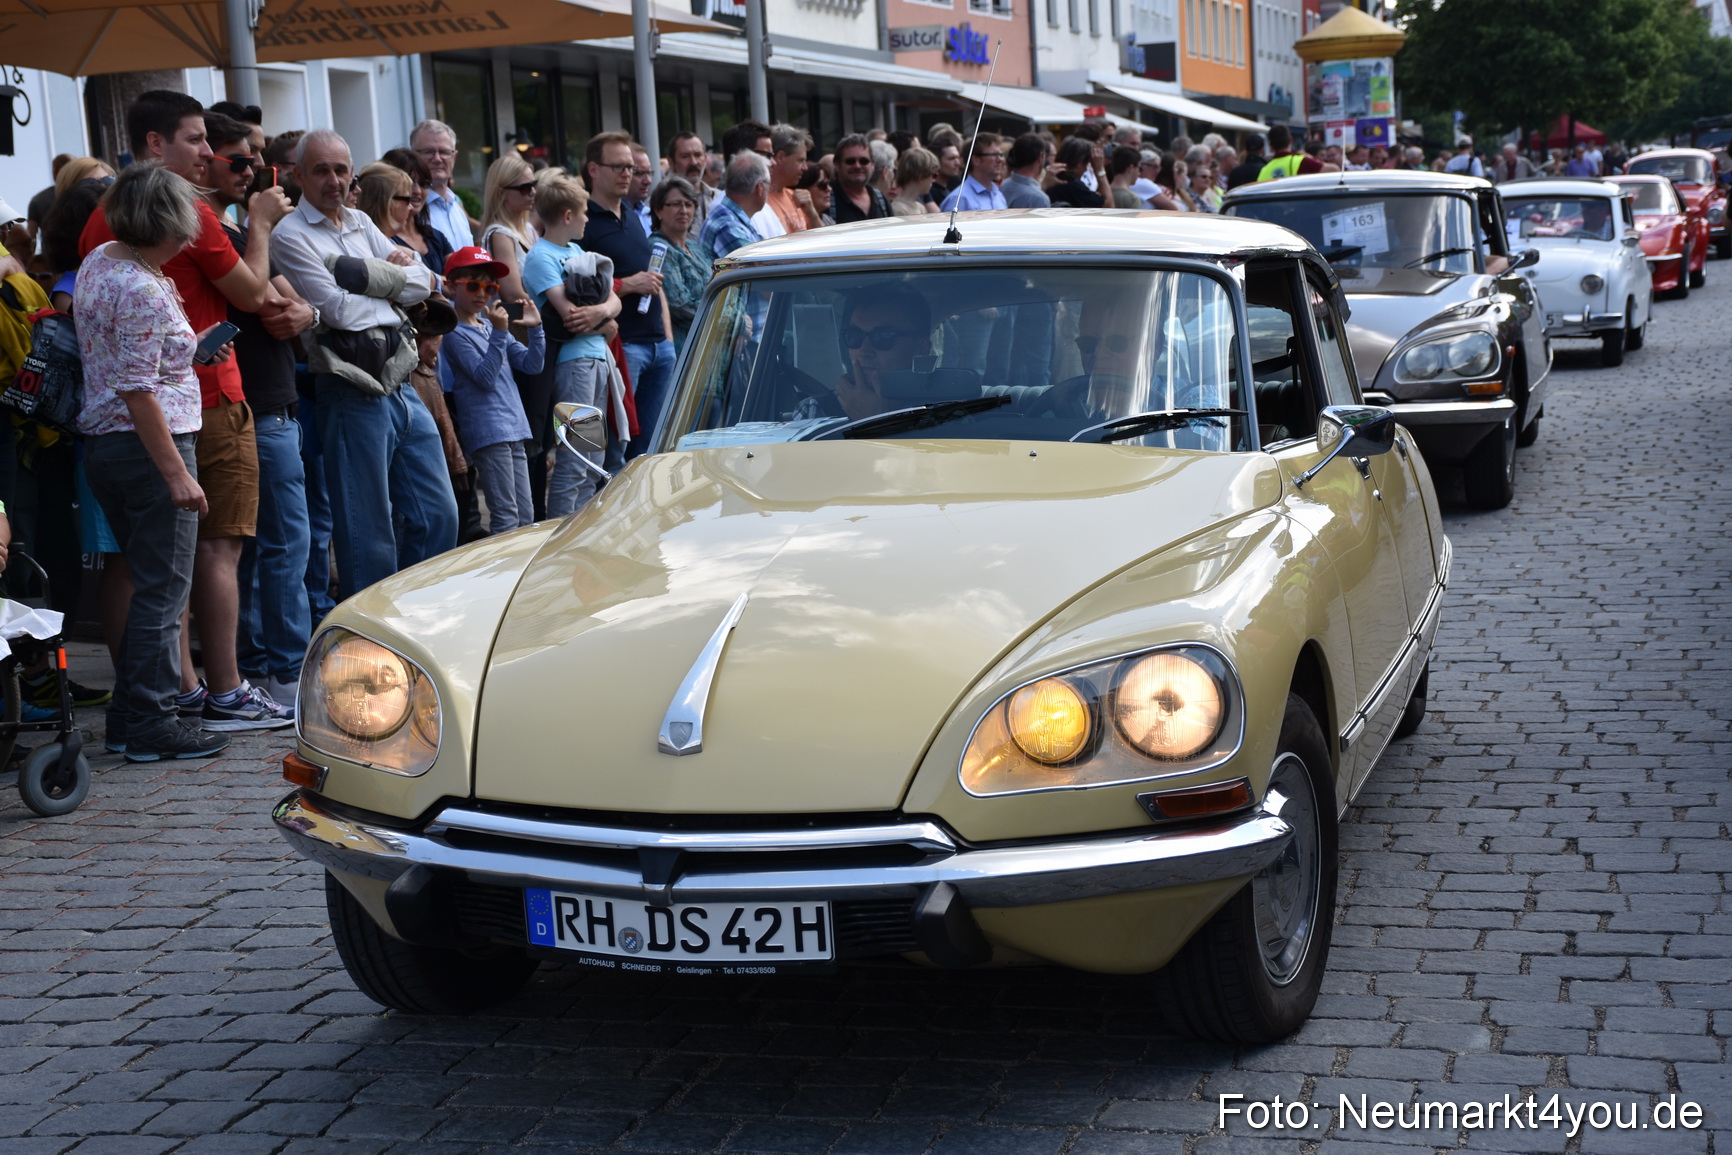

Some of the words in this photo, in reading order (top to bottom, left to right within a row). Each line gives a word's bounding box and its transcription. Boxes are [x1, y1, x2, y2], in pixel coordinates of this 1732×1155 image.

[1351, 214, 1374, 228] 163
[28, 357, 47, 369] YORK
[555, 895, 616, 948] RH
[536, 922, 547, 936] D
[579, 957, 615, 968] AUTOHAUS
[621, 962, 661, 973] SCHNEIDER
[676, 966, 712, 976] Geislingen
[722, 967, 736, 975] Tel.
